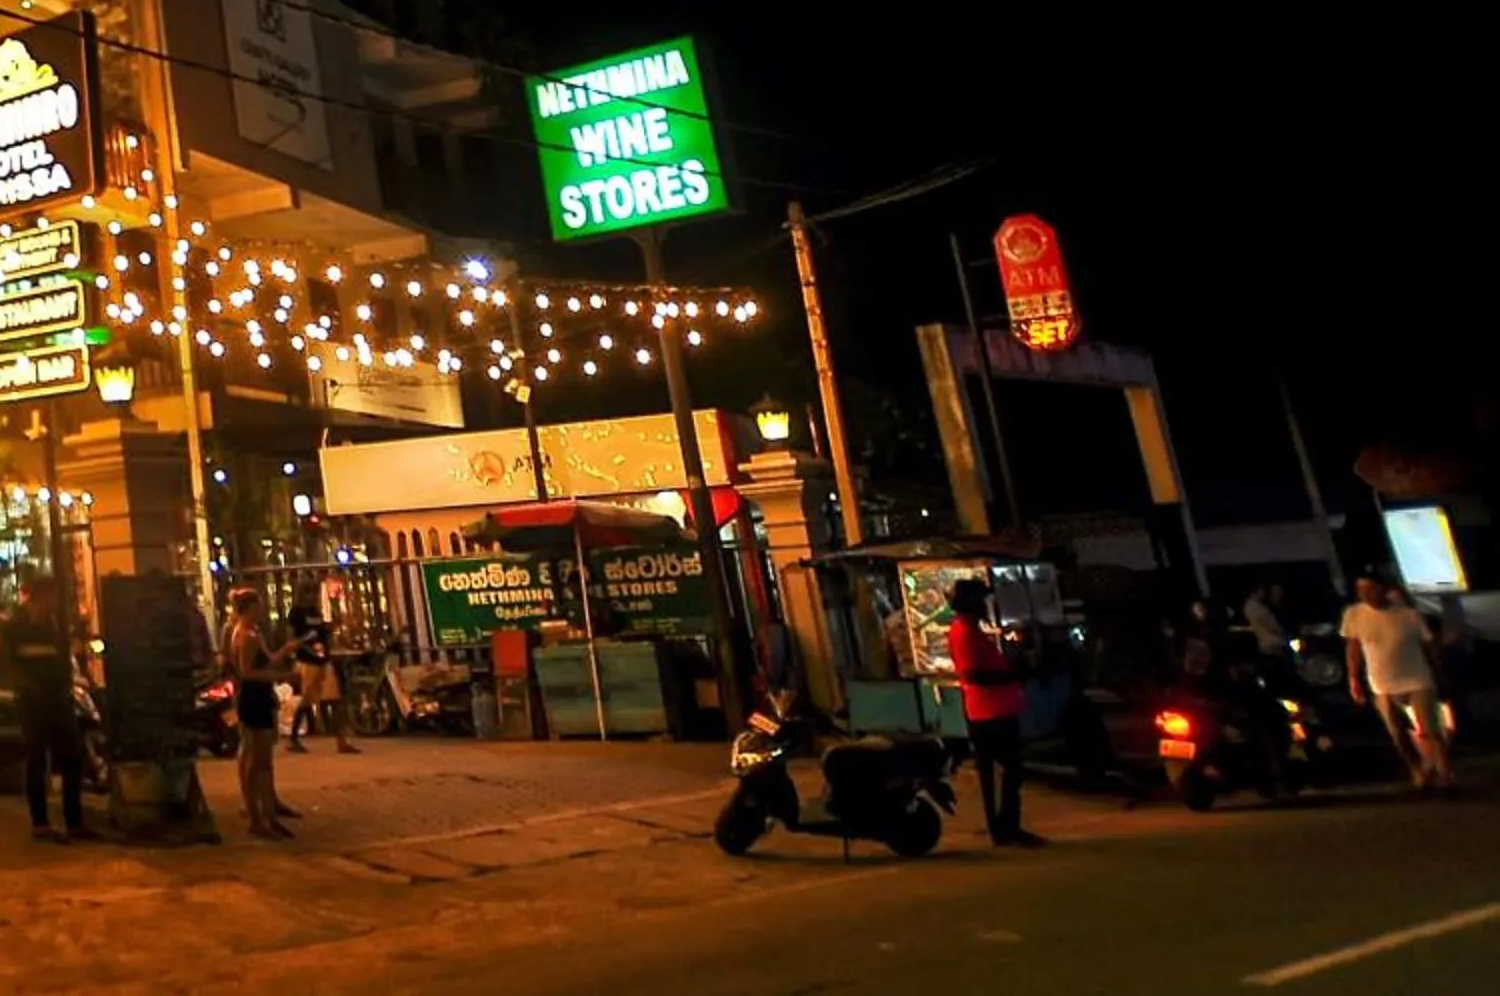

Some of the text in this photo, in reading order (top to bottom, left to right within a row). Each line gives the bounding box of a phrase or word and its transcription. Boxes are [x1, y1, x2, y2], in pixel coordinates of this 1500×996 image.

[570, 108, 673, 168] WINE
[560, 159, 709, 229] STORES
[1008, 266, 1060, 287] ATM
[606, 580, 677, 597] STORES
